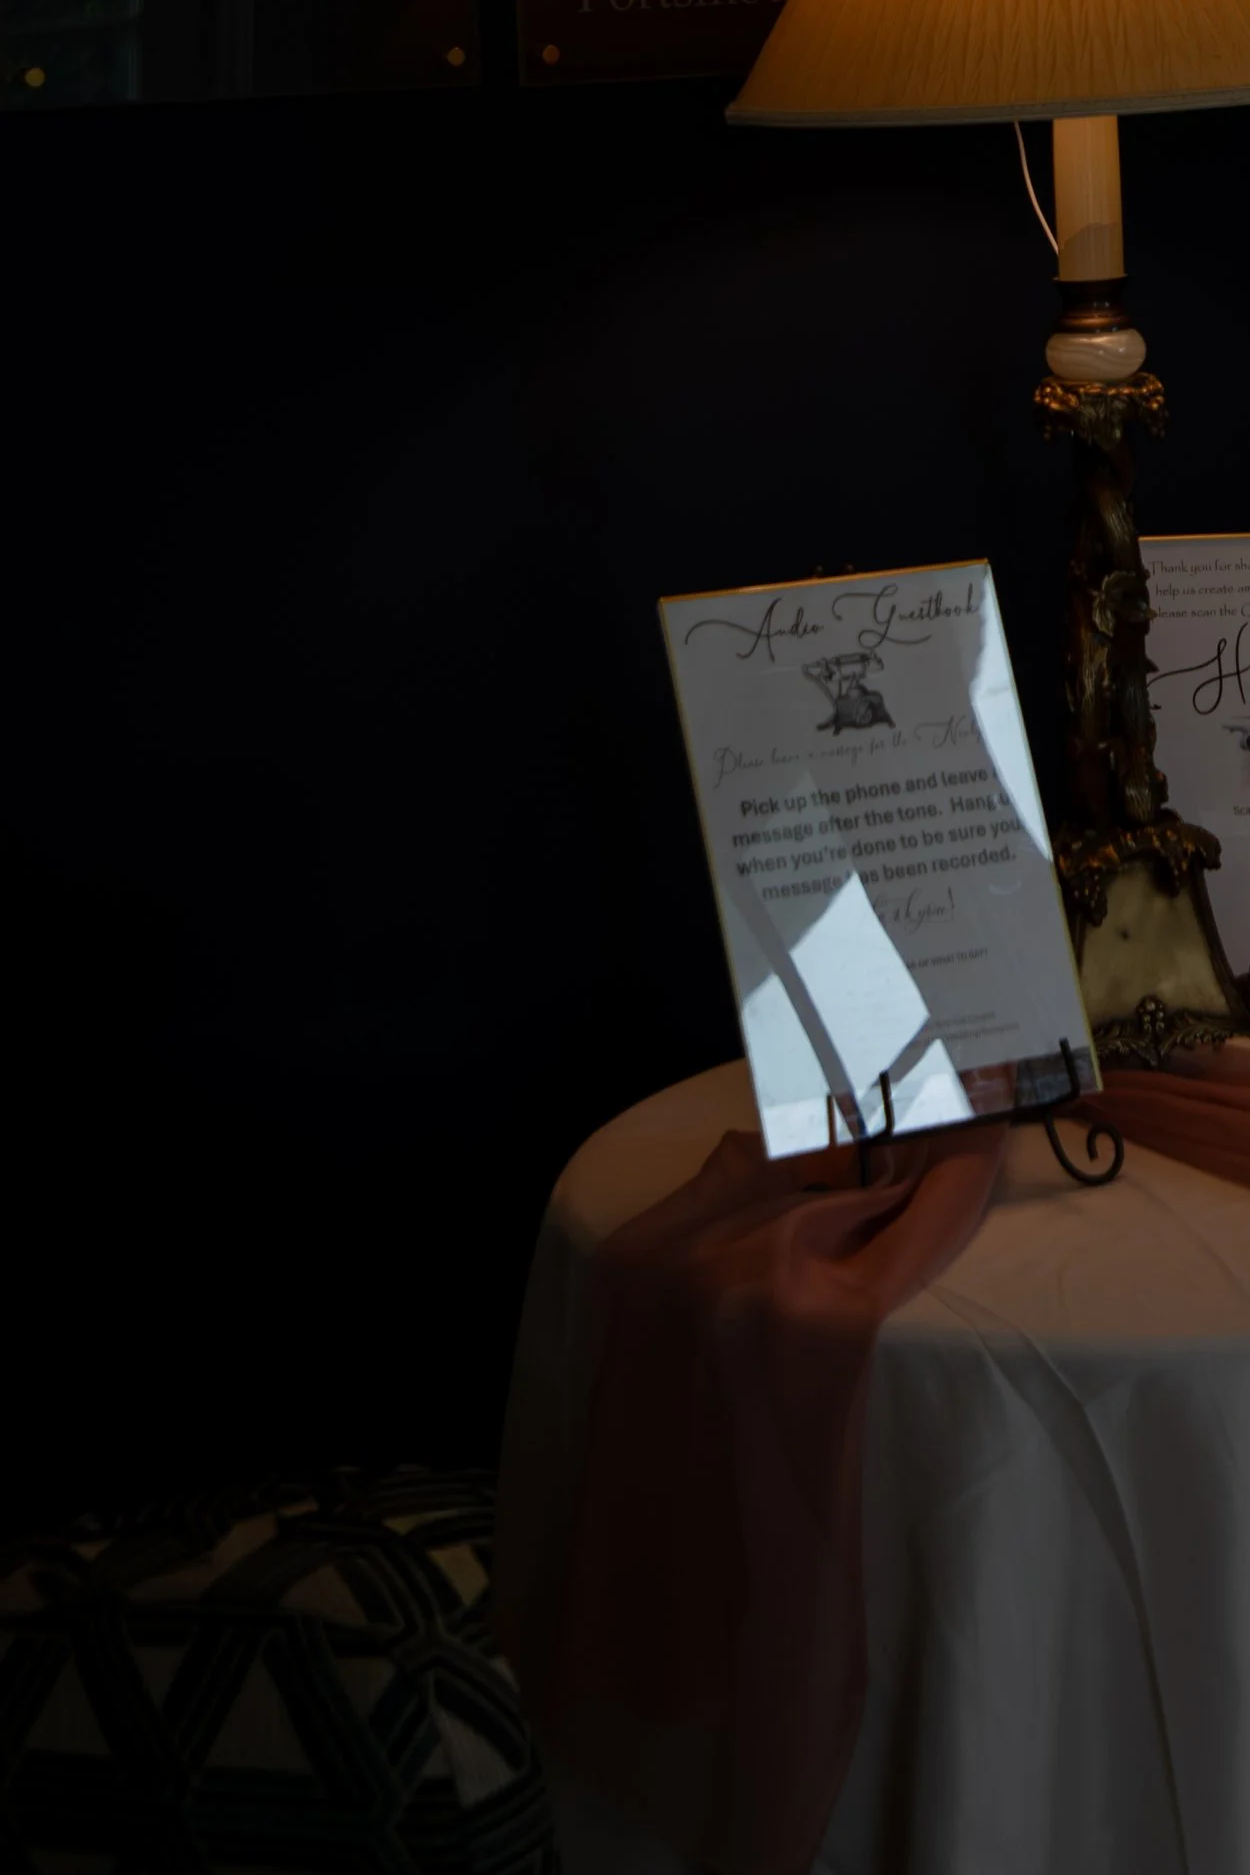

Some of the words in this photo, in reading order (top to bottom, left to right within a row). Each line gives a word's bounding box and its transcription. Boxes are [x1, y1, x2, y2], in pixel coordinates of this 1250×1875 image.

[1156, 583, 1179, 599] help
[1199, 586, 1234, 595] create
[685, 596, 824, 663] Audio
[831, 582, 979, 650] Guestbook
[740, 798, 780, 818] Pick
[784, 794, 807, 813] up
[811, 789, 841, 806] the
[845, 781, 901, 805] phone
[906, 773, 937, 793] and
[942, 767, 988, 788] leave
[732, 822, 814, 848] message
[818, 814, 860, 835] after
[864, 808, 893, 827] the
[897, 803, 942, 822] tone.
[950, 792, 997, 815] Hang
[736, 852, 793, 877] when
[851, 837, 897, 858] done
[899, 833, 918, 850] to
[922, 826, 943, 846] be
[948, 824, 986, 843] sure
[762, 876, 845, 901] message
[845, 868, 880, 886] as
[882, 861, 928, 884] been
[931, 844, 1016, 872] recorded.
